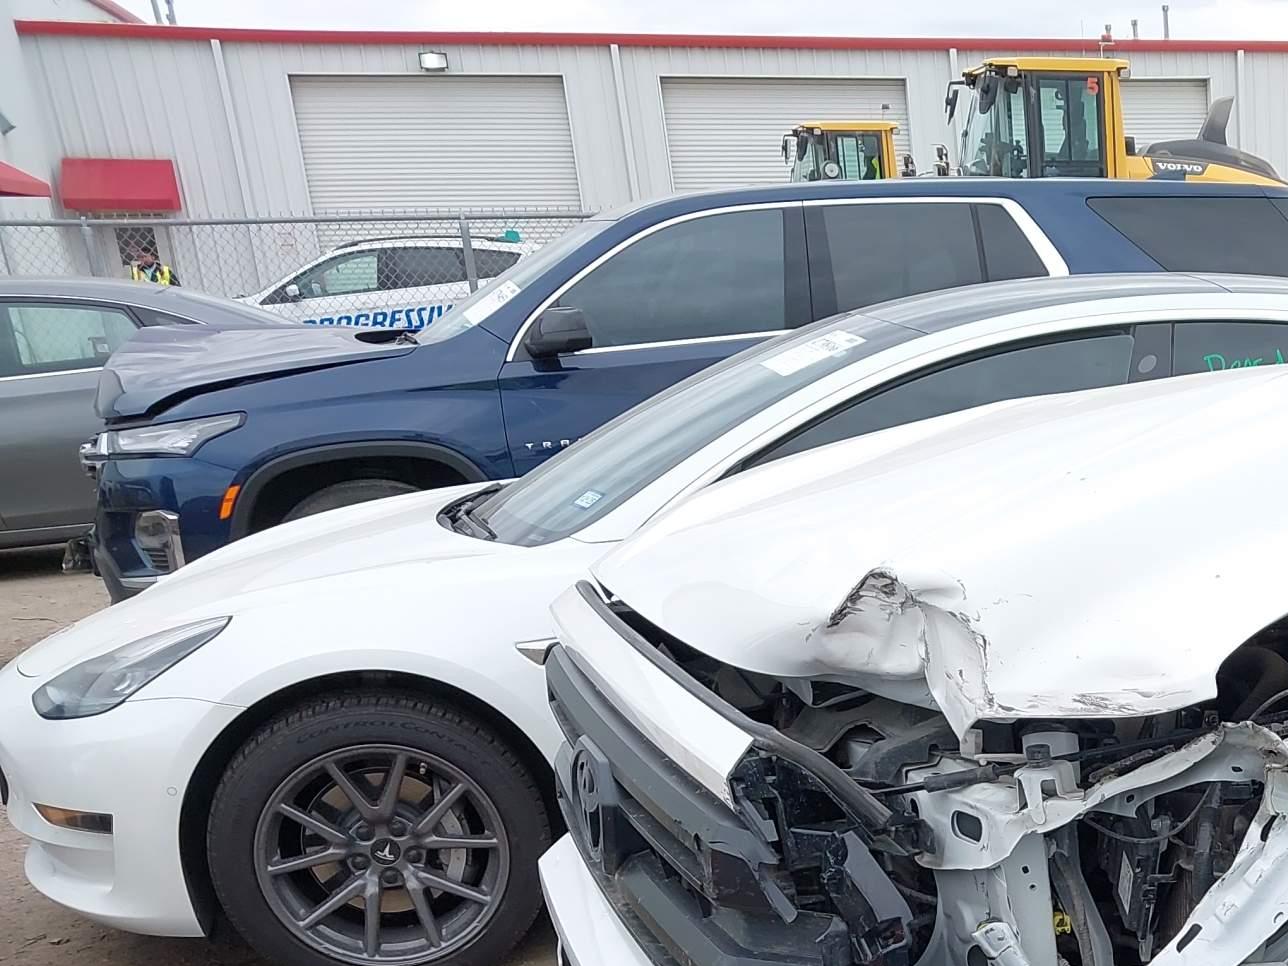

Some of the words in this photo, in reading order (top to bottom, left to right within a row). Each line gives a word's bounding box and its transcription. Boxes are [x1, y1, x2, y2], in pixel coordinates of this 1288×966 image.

[1087, 76, 1099, 95] 5
[1155, 162, 1203, 172] VOLVO
[303, 304, 455, 328] GRESSIV
[524, 438, 582, 450] TRA
